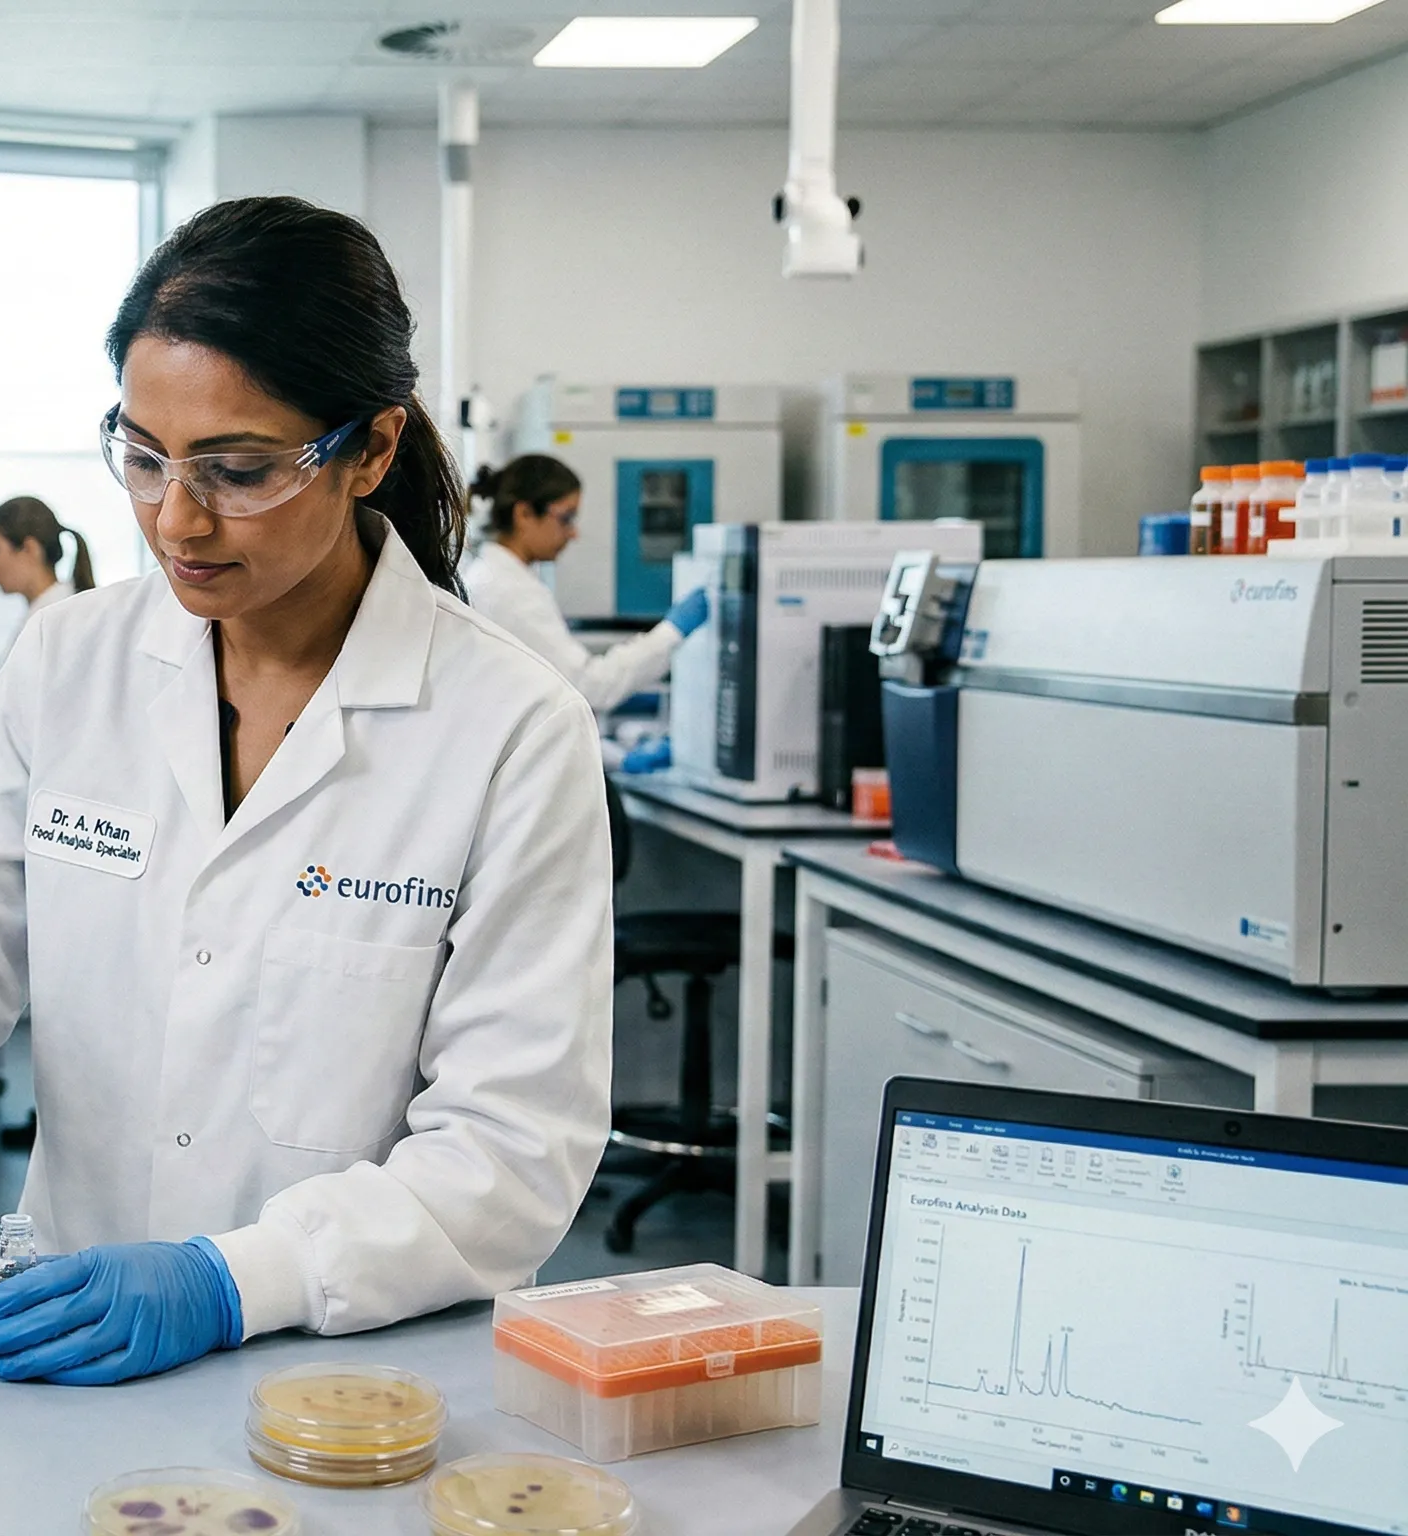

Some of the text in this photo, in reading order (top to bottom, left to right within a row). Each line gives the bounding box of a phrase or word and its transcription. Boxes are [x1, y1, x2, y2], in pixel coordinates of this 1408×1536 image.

[32, 824, 55, 841] Food
[51, 808, 130, 842] Dr. A. Khan
[337, 876, 456, 909] eurofins
[1001, 1206, 1027, 1219] Data
